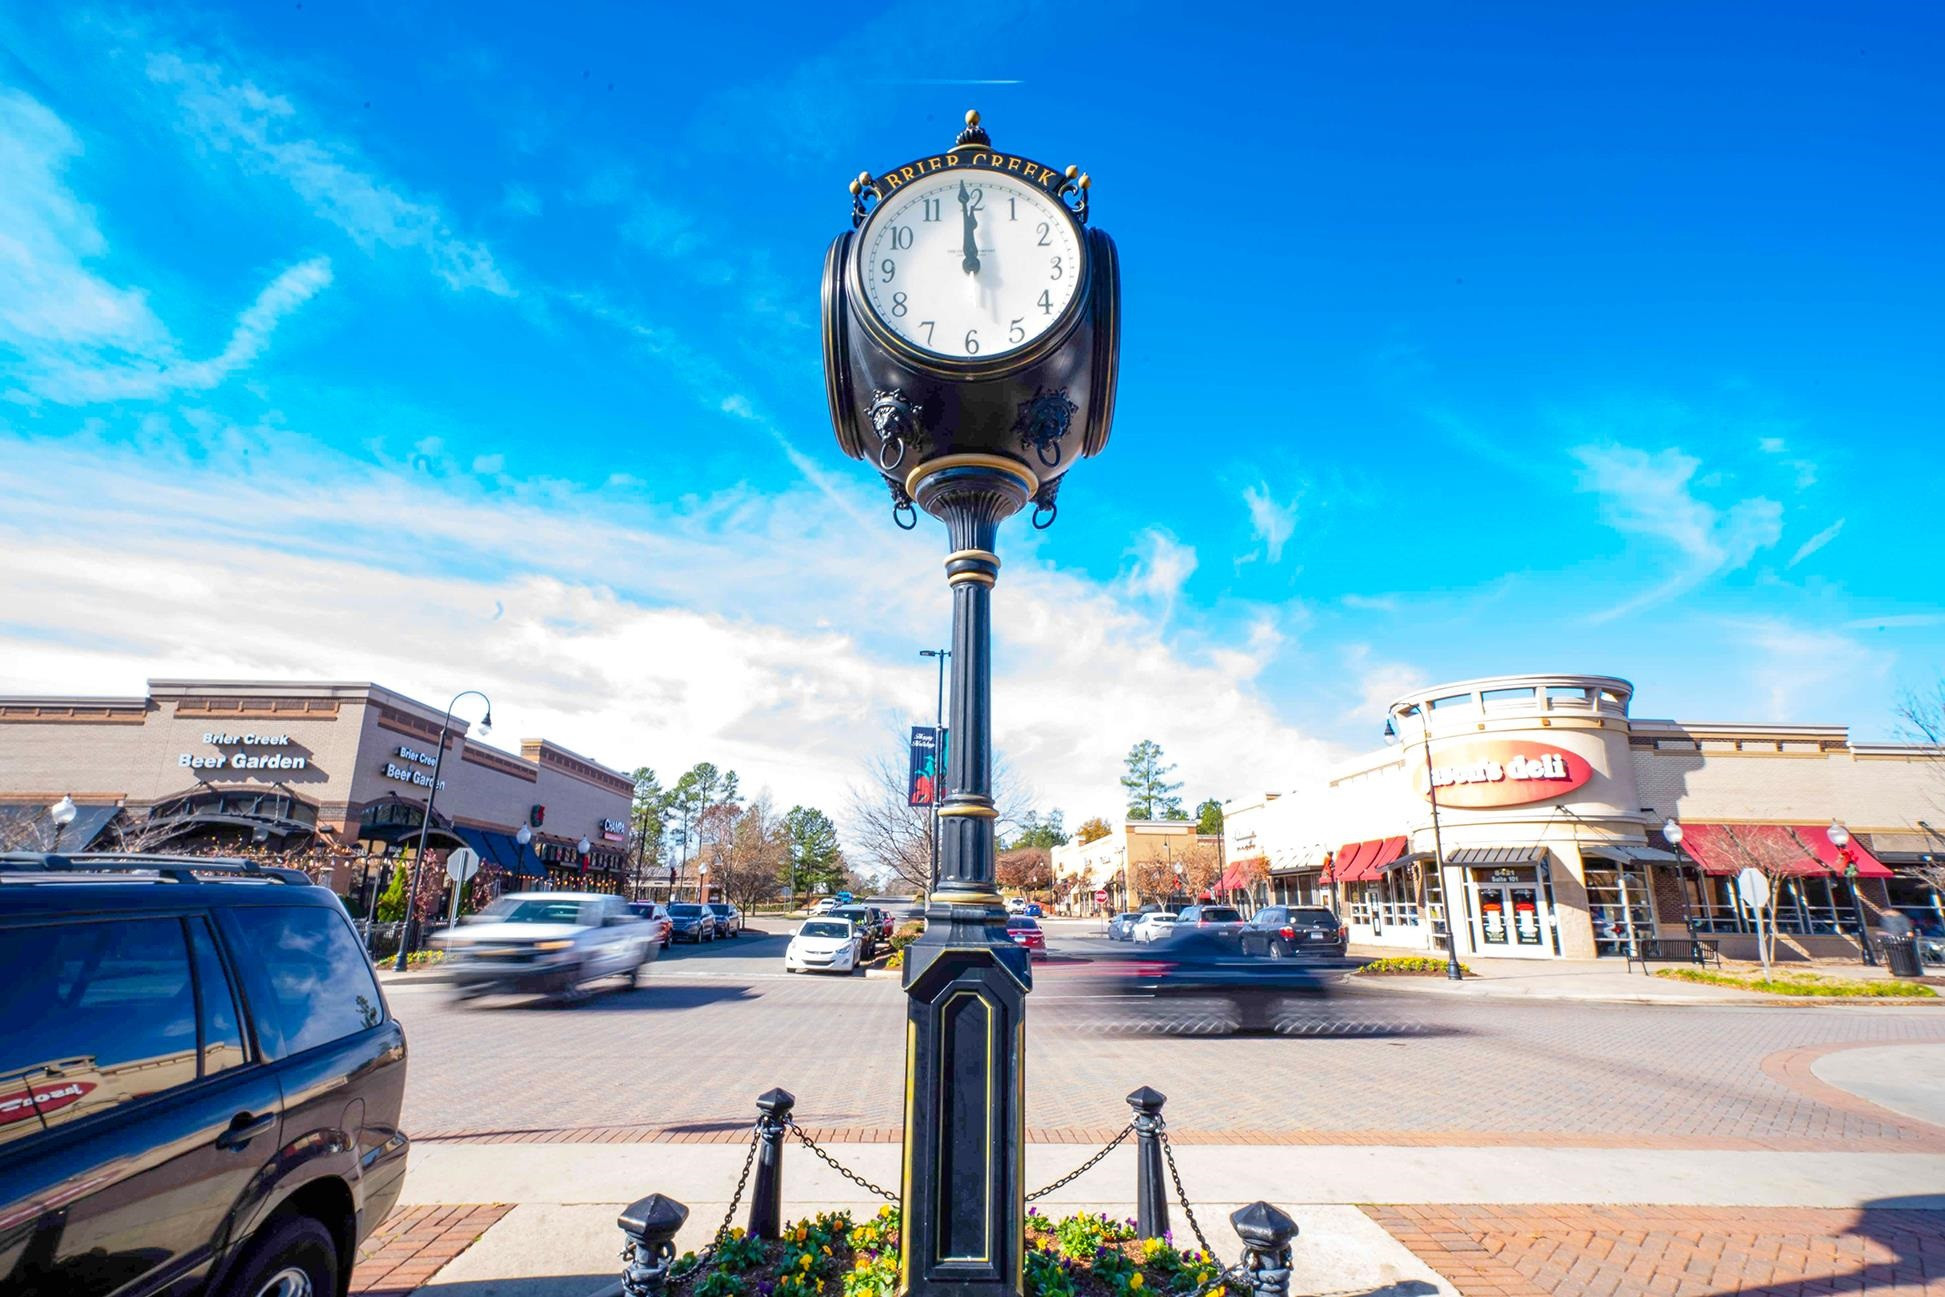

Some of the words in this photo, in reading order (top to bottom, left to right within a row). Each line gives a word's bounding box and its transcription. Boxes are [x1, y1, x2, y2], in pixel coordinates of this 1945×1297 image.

[884, 154, 959, 189] BRIER
[973, 153, 1057, 187] CREEK
[922, 198, 942, 222] 11
[1007, 197, 1018, 222] 1
[889, 225, 914, 250] 10
[1036, 222, 1053, 247] 2
[881, 258, 896, 284] 9
[1050, 256, 1063, 280] 3
[891, 291, 908, 318] 8
[1037, 289, 1054, 315] 4
[918, 321, 936, 347] 7
[964, 329, 980, 355] 6
[1008, 316, 1026, 344] 5
[202, 732, 241, 745] Brier
[243, 732, 289, 746] Creek
[178, 752, 227, 769] Beer
[231, 752, 306, 769] Garden
[400, 746, 419, 761] Brier
[420, 752, 438, 767] Cree
[1506, 753, 1566, 780] deli
[386, 763, 412, 782] Beer
